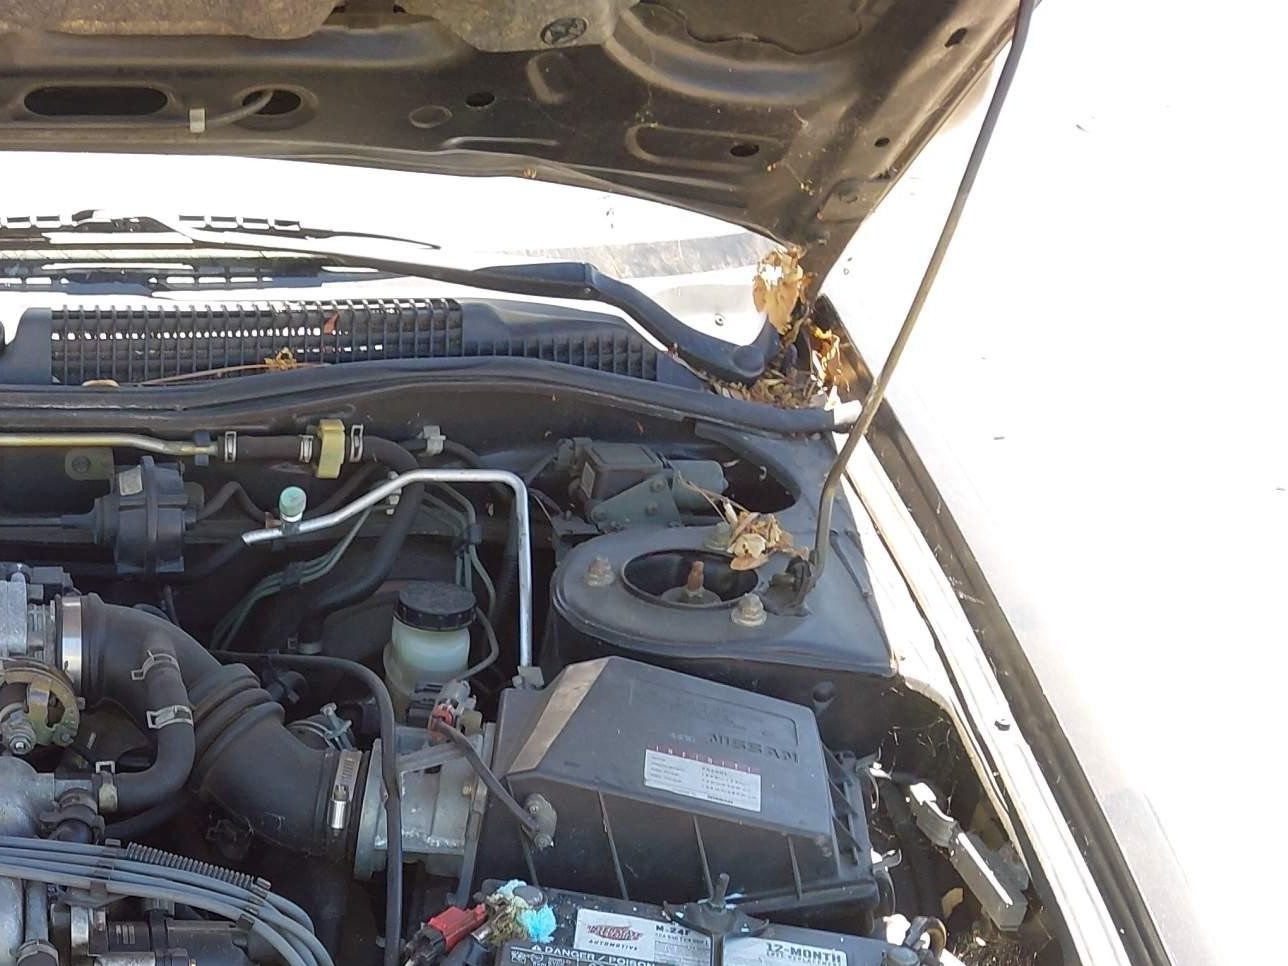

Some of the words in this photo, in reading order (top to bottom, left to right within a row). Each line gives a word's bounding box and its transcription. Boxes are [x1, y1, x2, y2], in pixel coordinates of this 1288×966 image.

[710, 733, 799, 764] NISSAN
[545, 946, 595, 961] DANGER
[589, 939, 638, 951] AUTOMOTIVE
[765, 942, 842, 964] 12-MONTH
